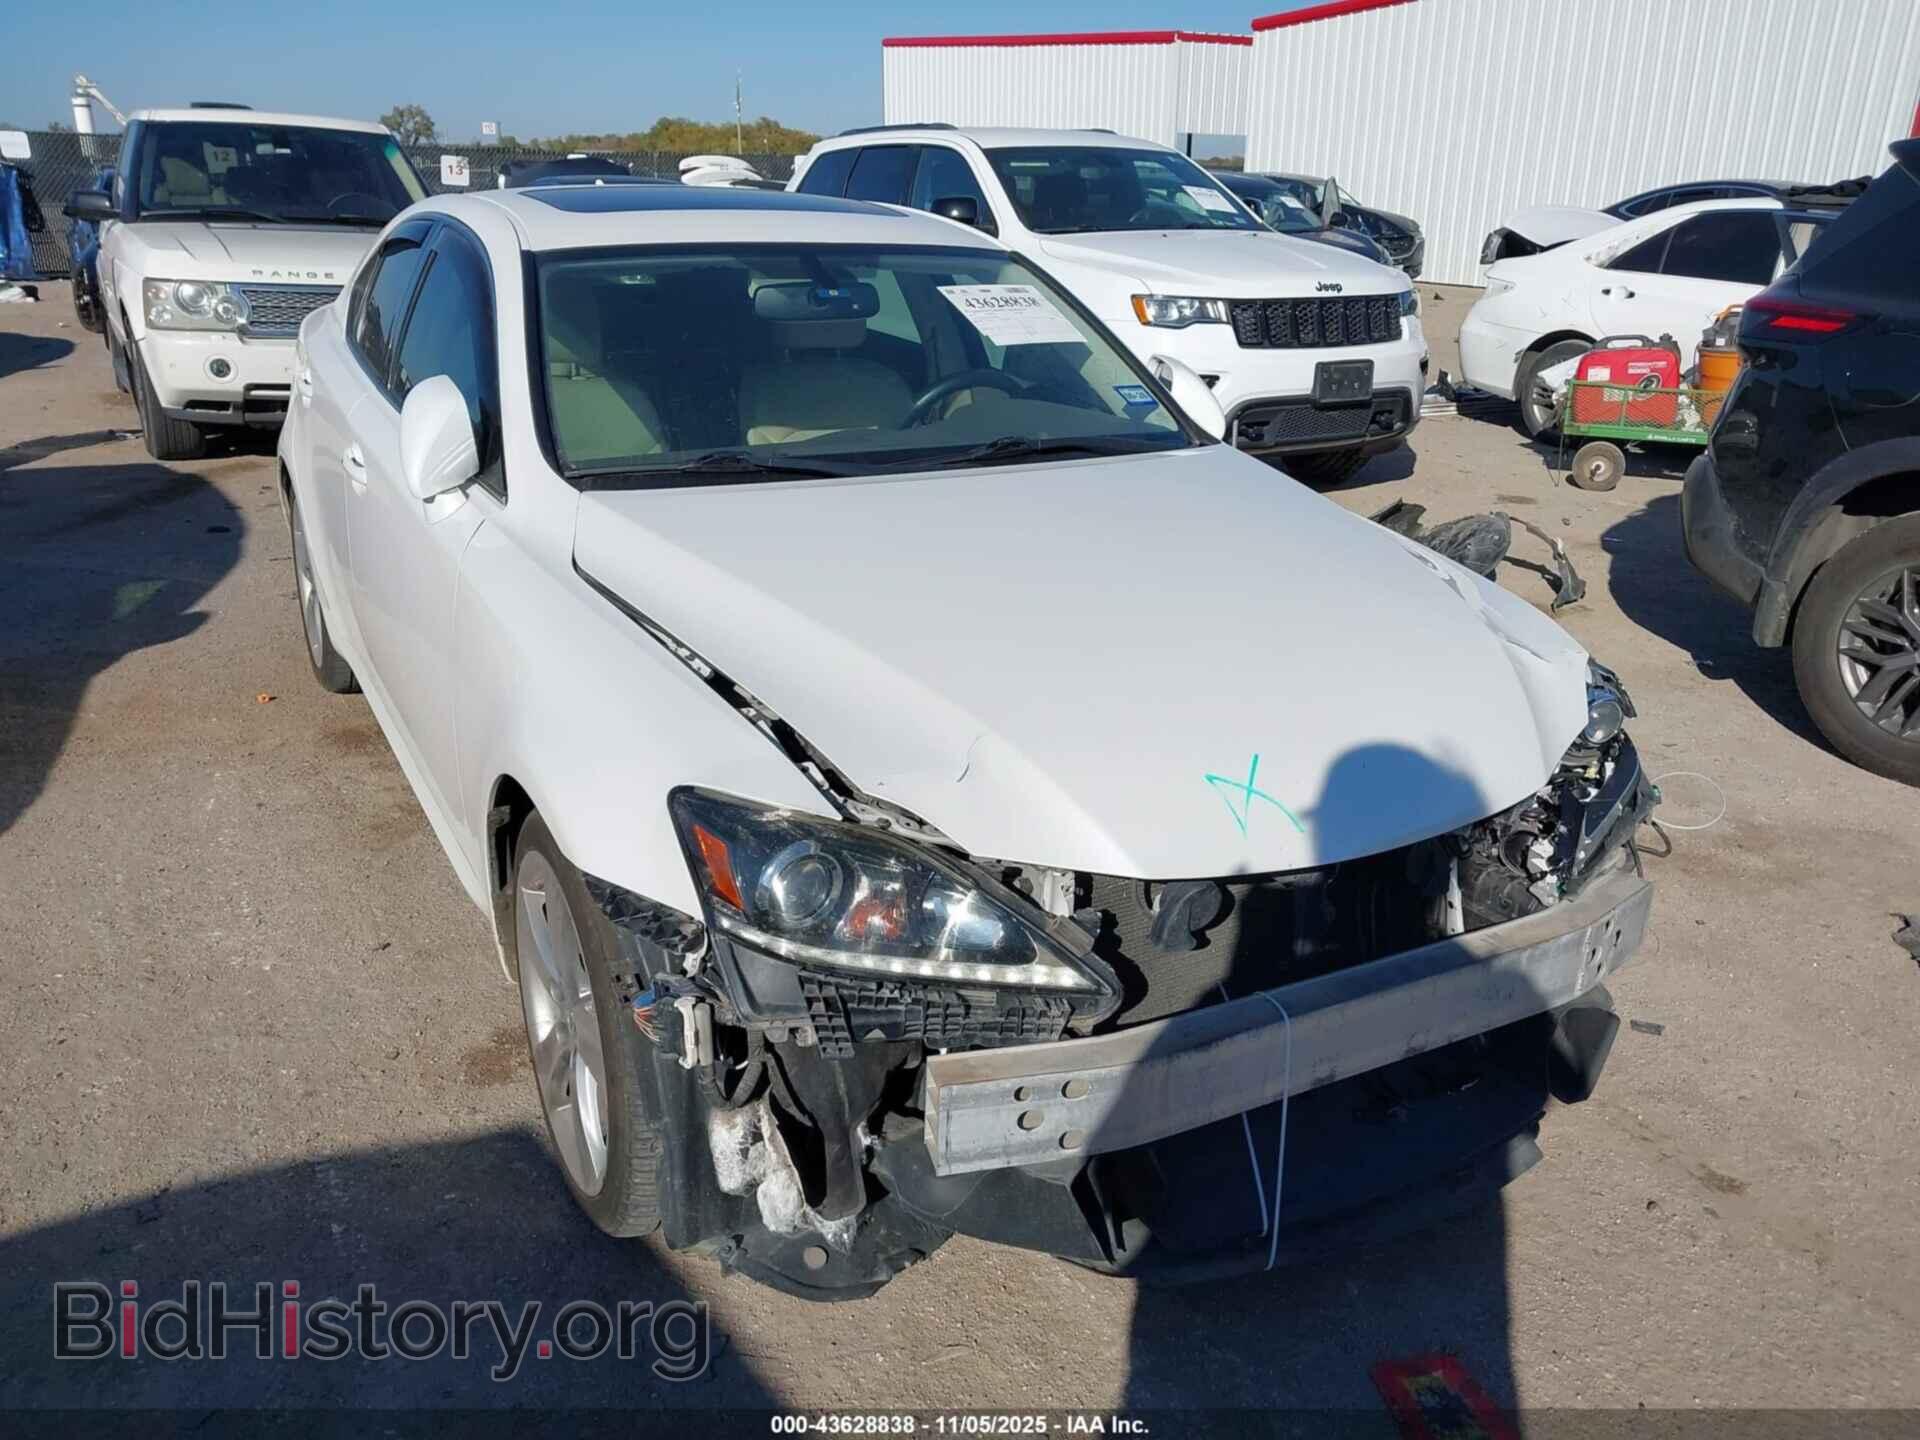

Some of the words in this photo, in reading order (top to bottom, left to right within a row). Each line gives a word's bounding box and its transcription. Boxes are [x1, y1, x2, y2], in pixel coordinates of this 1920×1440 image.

[447, 164, 465, 176] 13
[251, 269, 335, 279] RANGE
[1315, 280, 1343, 294] Jeep
[964, 295, 1041, 309] 43628838
